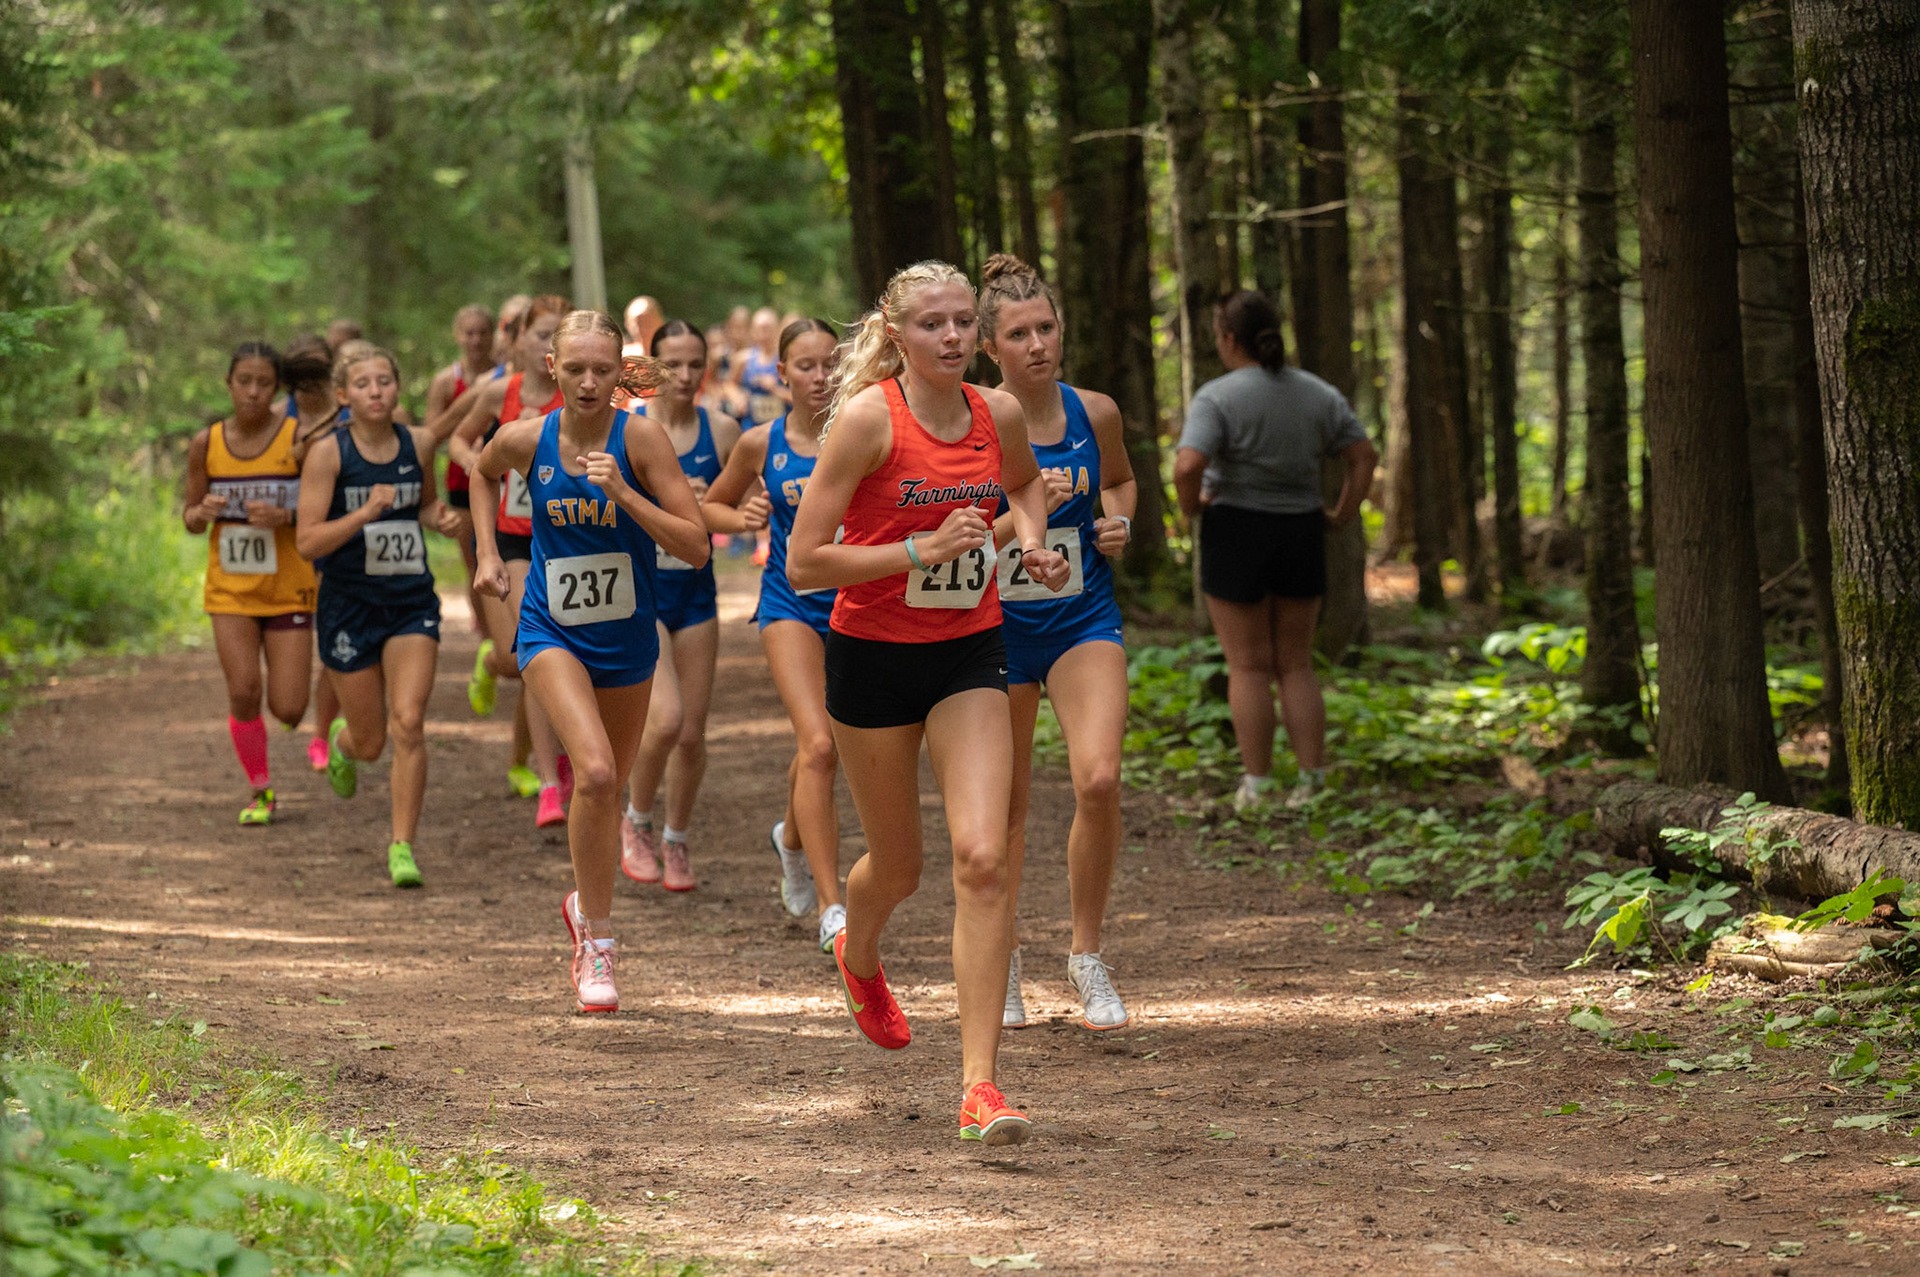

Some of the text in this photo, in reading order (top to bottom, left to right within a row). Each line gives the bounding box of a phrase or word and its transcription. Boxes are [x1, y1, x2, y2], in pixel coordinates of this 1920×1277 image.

[781, 476, 812, 507] ST
[896, 477, 1001, 508] Farmingto
[546, 498, 617, 529] STMA
[228, 536, 266, 564] 170
[376, 533, 416, 563] 232
[920, 547, 985, 591] 213
[559, 567, 619, 611] 237
